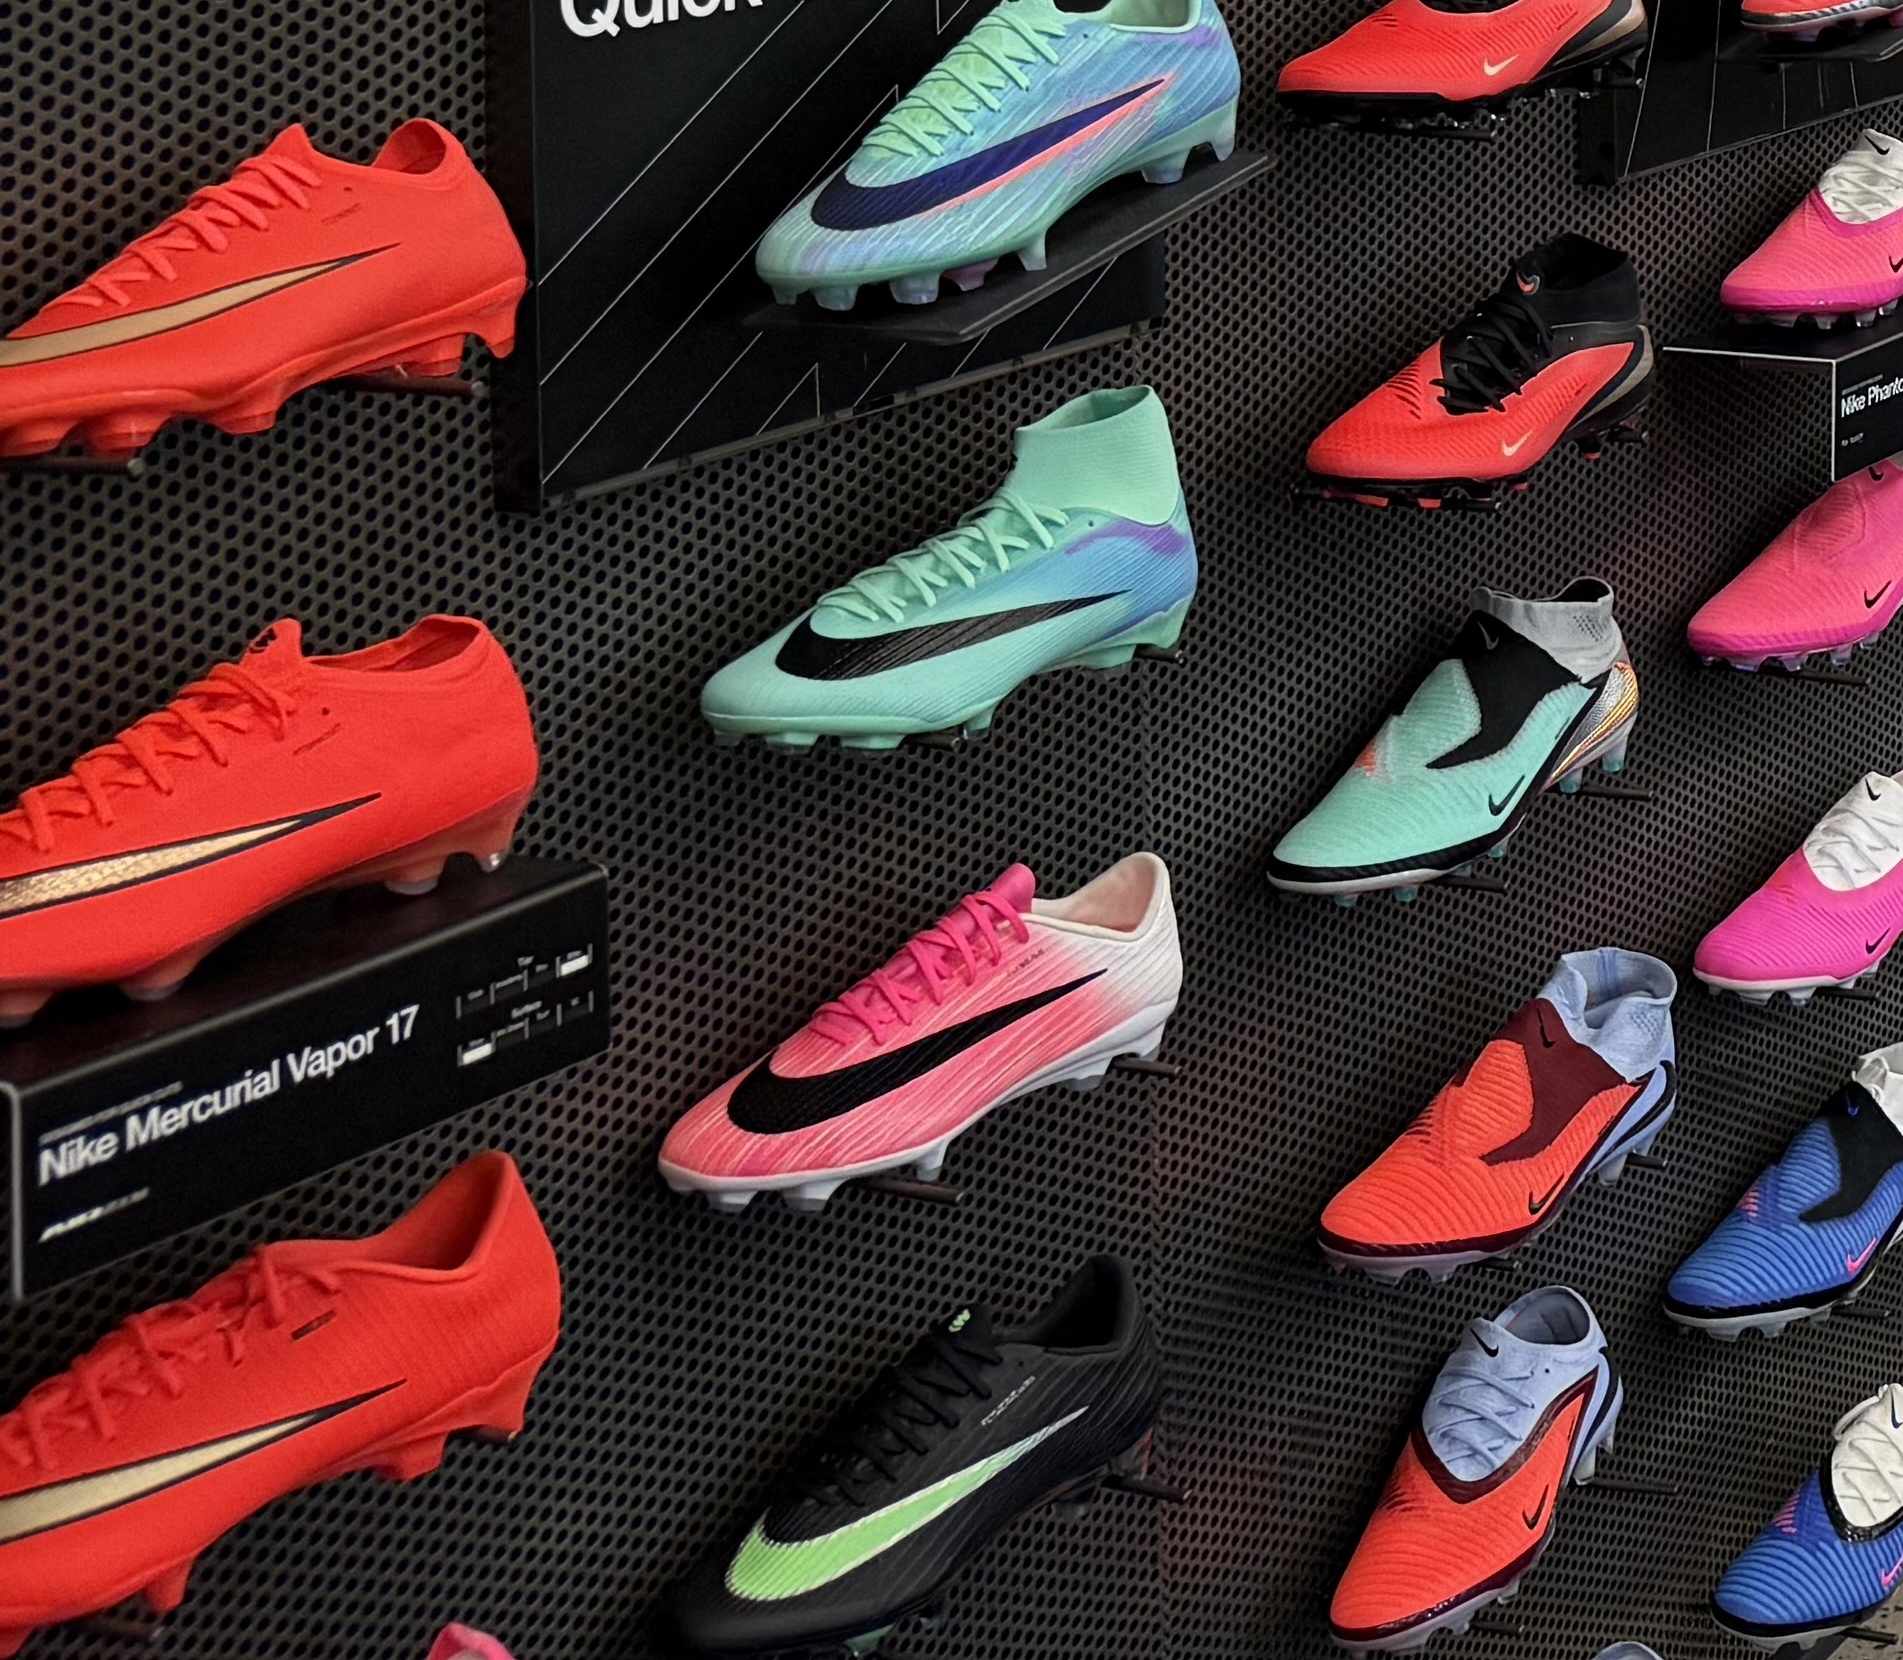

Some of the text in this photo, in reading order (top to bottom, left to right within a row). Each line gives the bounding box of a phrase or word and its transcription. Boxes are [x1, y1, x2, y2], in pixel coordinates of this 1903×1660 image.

[1841, 394, 1866, 418] Nike
[38, 1130, 119, 1187] Nike
[124, 1058, 281, 1153] Mercurial
[285, 1027, 381, 1083] Vapor
[385, 1003, 420, 1045] 17
